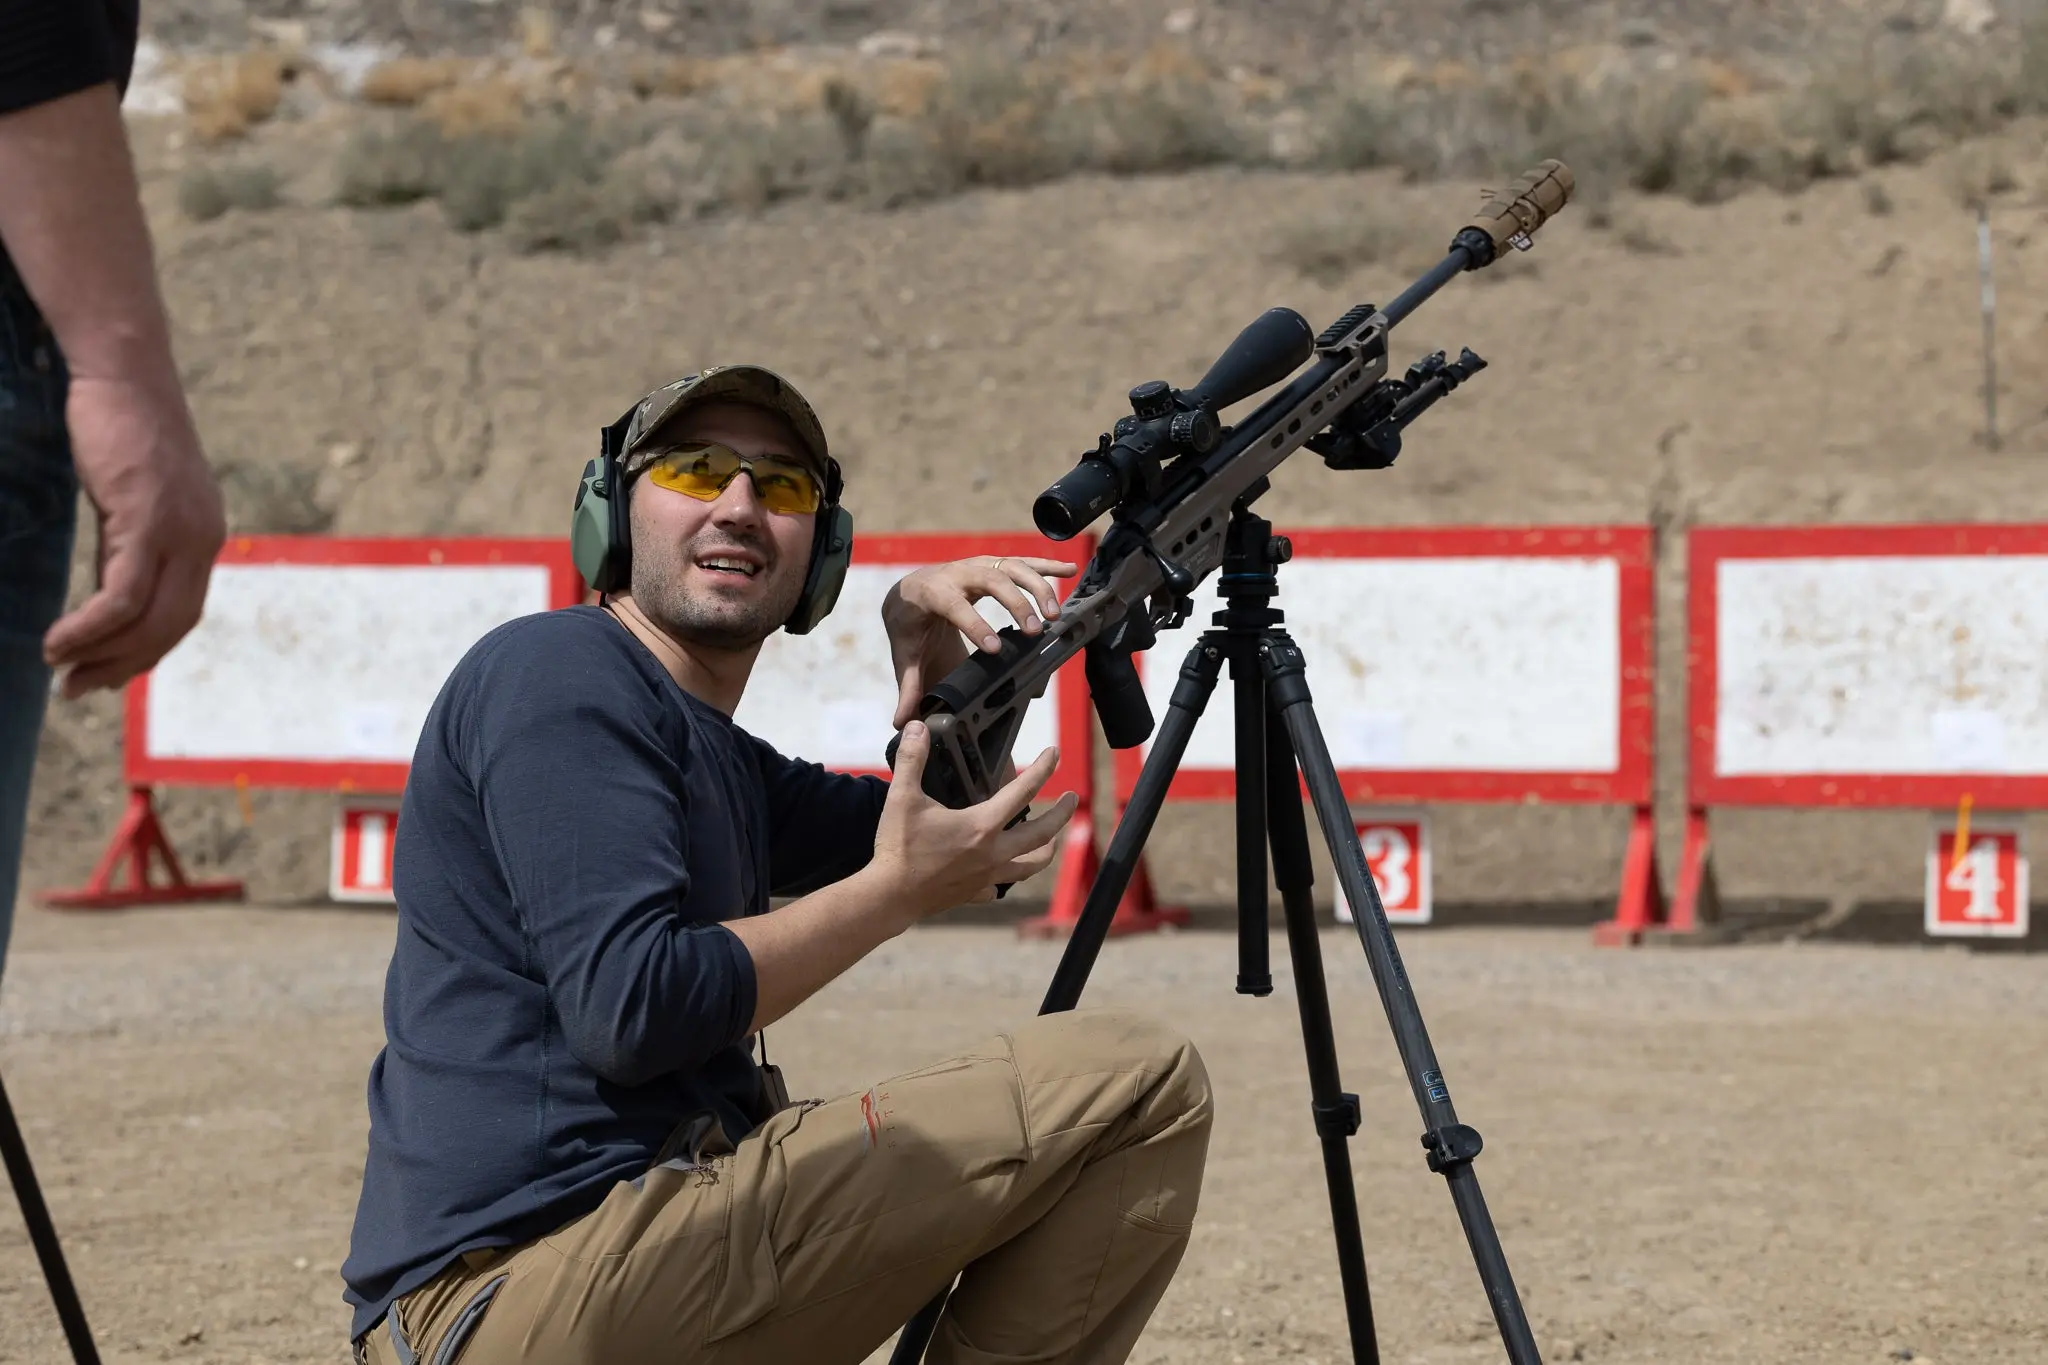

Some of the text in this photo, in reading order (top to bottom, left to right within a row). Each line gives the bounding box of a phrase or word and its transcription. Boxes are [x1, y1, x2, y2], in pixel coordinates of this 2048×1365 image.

[358, 813, 387, 887] 1
[1361, 827, 1411, 908] 3
[1945, 838, 2005, 919] 4
